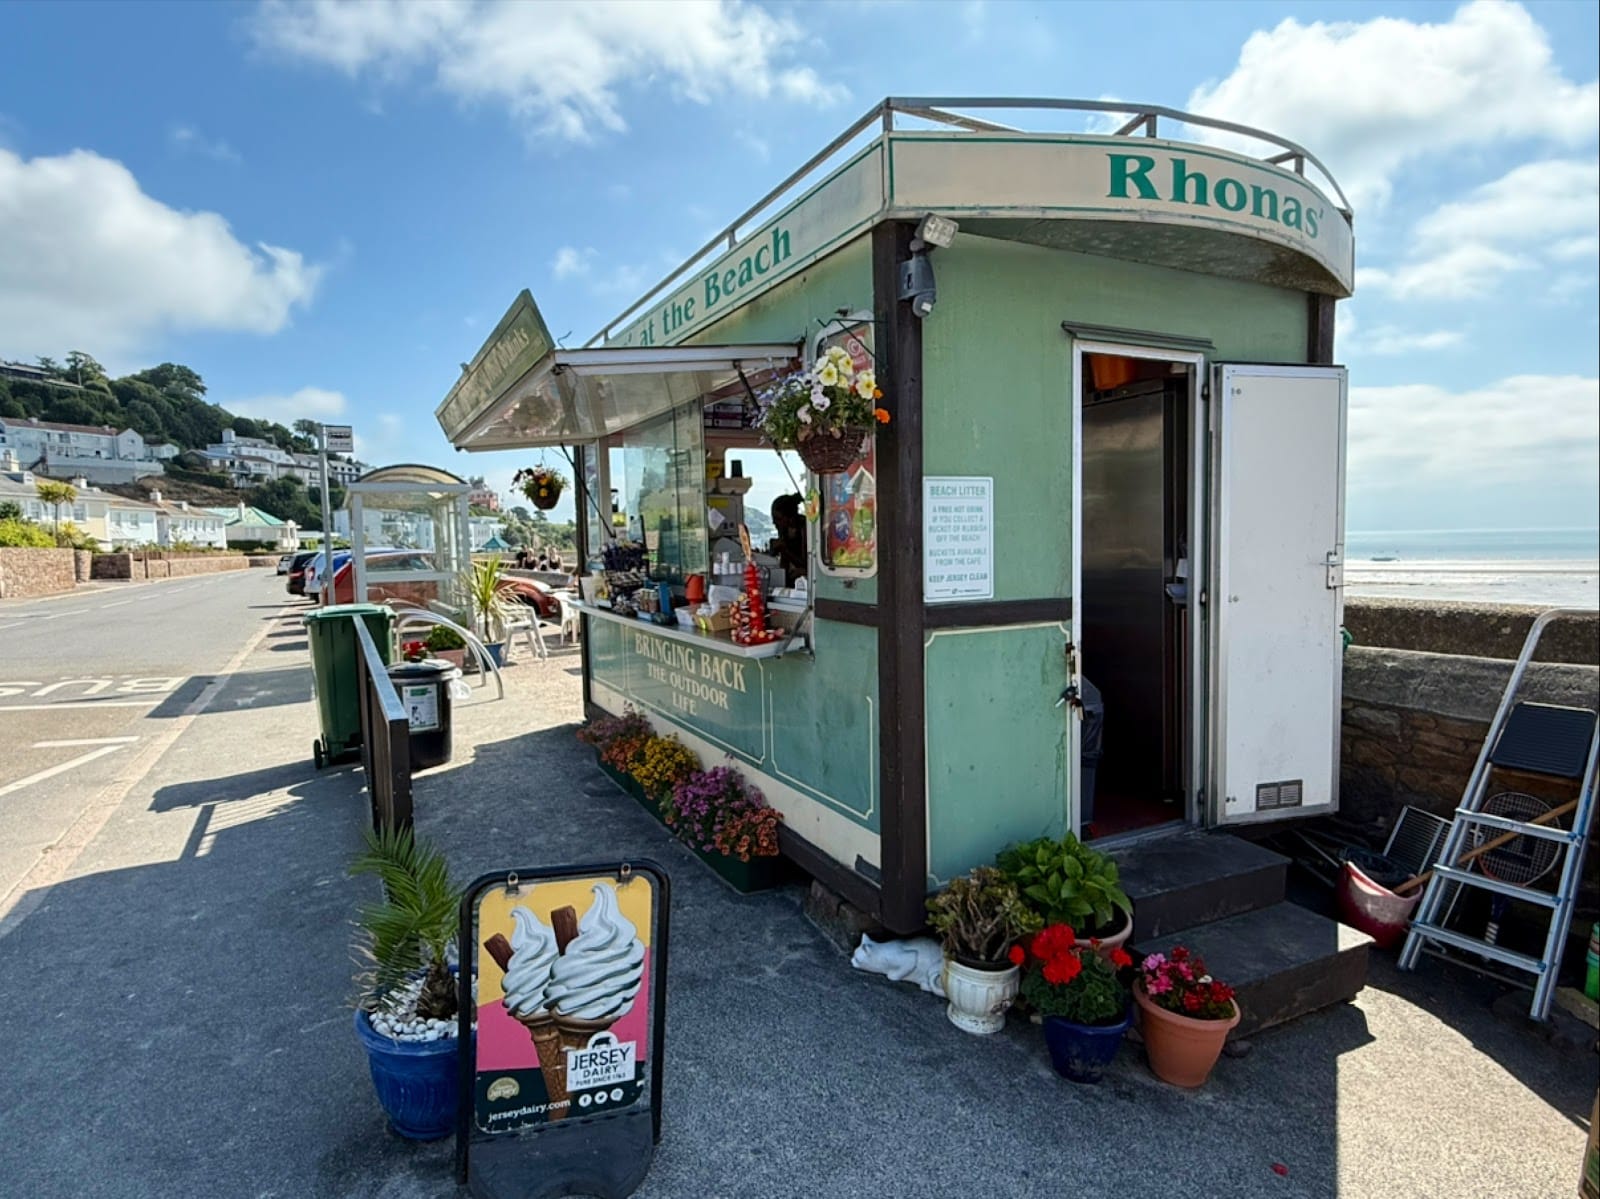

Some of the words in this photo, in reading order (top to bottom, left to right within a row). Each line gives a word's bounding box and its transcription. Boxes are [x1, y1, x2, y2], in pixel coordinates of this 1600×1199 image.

[1105, 153, 1324, 239] Rhonas'
[640, 318, 656, 346] at
[662, 295, 695, 336] the
[704, 226, 792, 310] Beach
[930, 486, 957, 496] BEACH
[959, 486, 986, 496] LITTER
[939, 515, 952, 523] YOU
[953, 515, 978, 523] COLLECT
[928, 525, 952, 533] BUCKET
[949, 534, 960, 542] THE
[957, 548, 987, 556] AVAILABLE
[936, 558, 953, 566] FROM
[928, 575, 945, 583] KEEP
[945, 574, 968, 582] JERSEY
[968, 572, 988, 580] CLEAN
[635, 633, 696, 674] BRINGING
[700, 652, 746, 693] BACK
[648, 662, 666, 682] THE
[669, 671, 729, 711] OUTDOOR
[672, 691, 697, 716] LIFE
[570, 1046, 631, 1071] JERSEY
[583, 1064, 618, 1078] DAIRY
[575, 1079, 591, 1087] PURE
[592, 1075, 611, 1084] SINCE
[488, 1099, 571, 1123] jerseydairy.com
